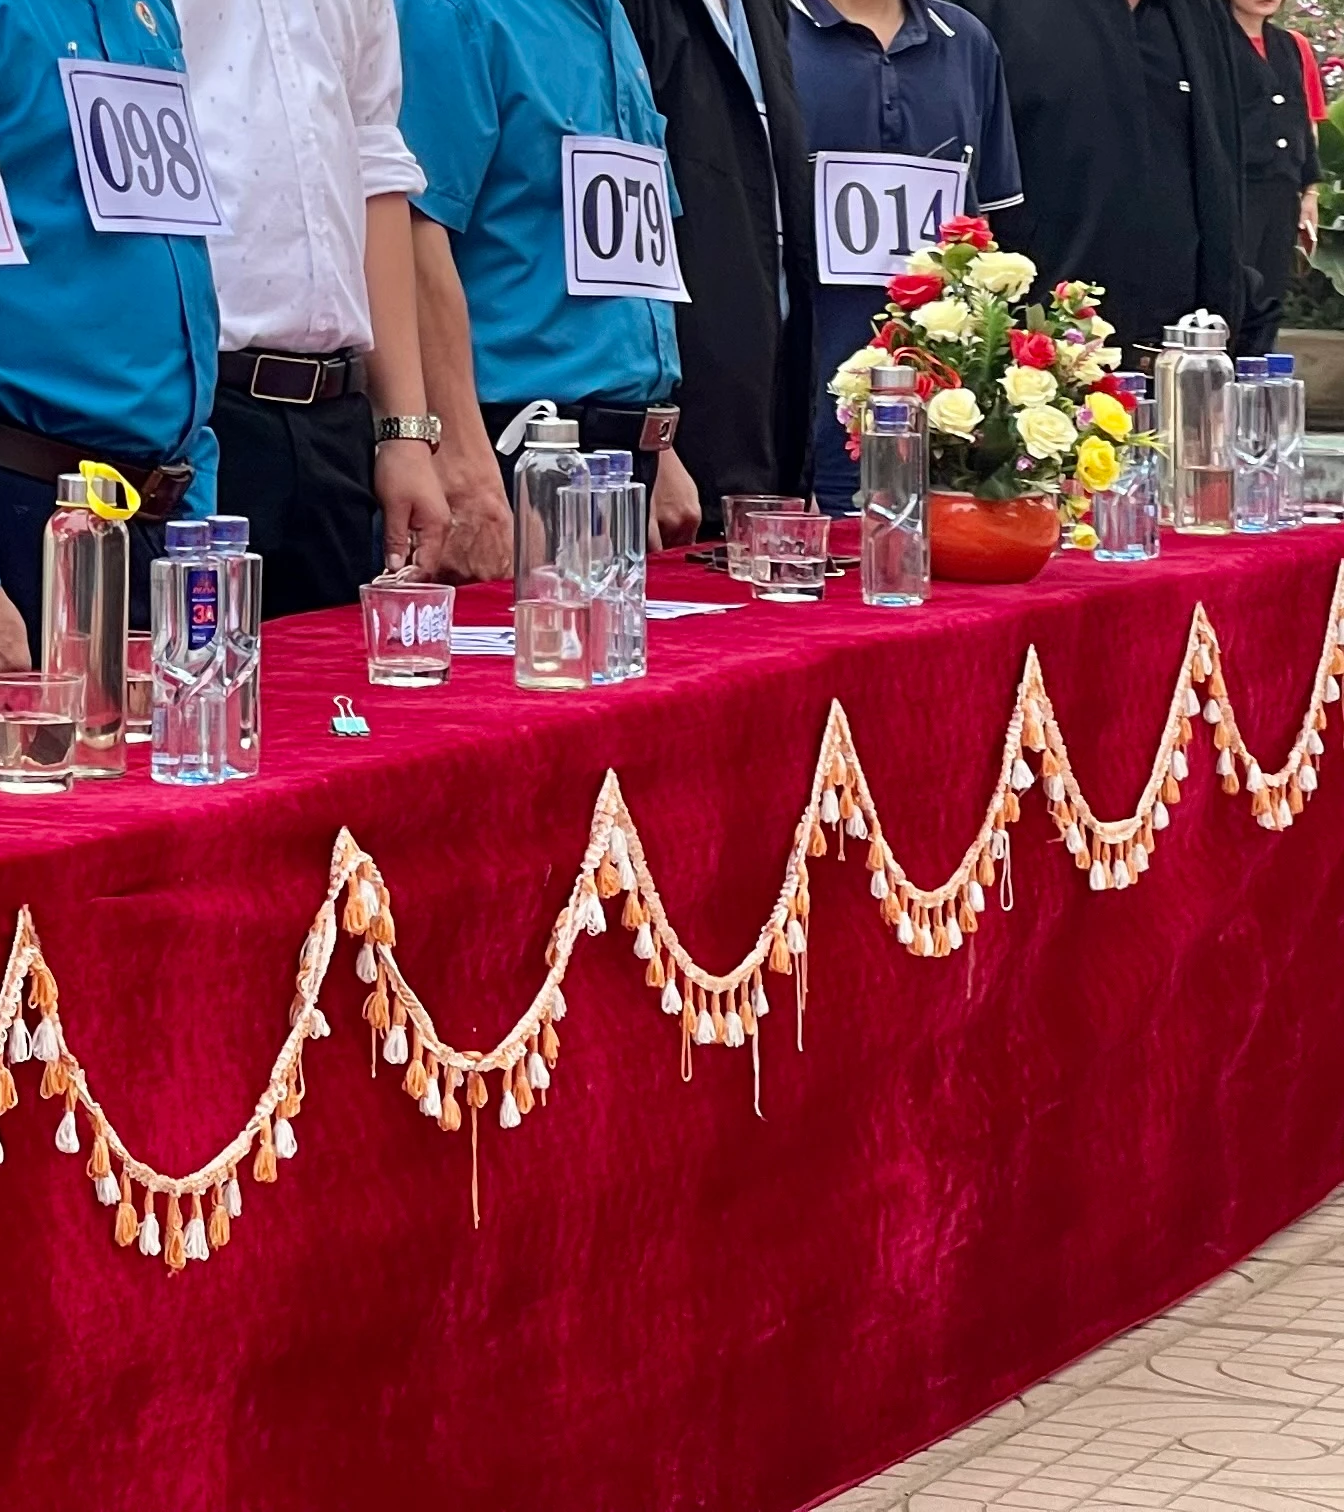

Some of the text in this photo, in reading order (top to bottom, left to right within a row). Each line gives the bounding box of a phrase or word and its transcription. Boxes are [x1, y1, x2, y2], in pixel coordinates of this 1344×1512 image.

[89, 96, 201, 201] 098
[582, 173, 667, 268] 079
[834, 181, 943, 256] 014
